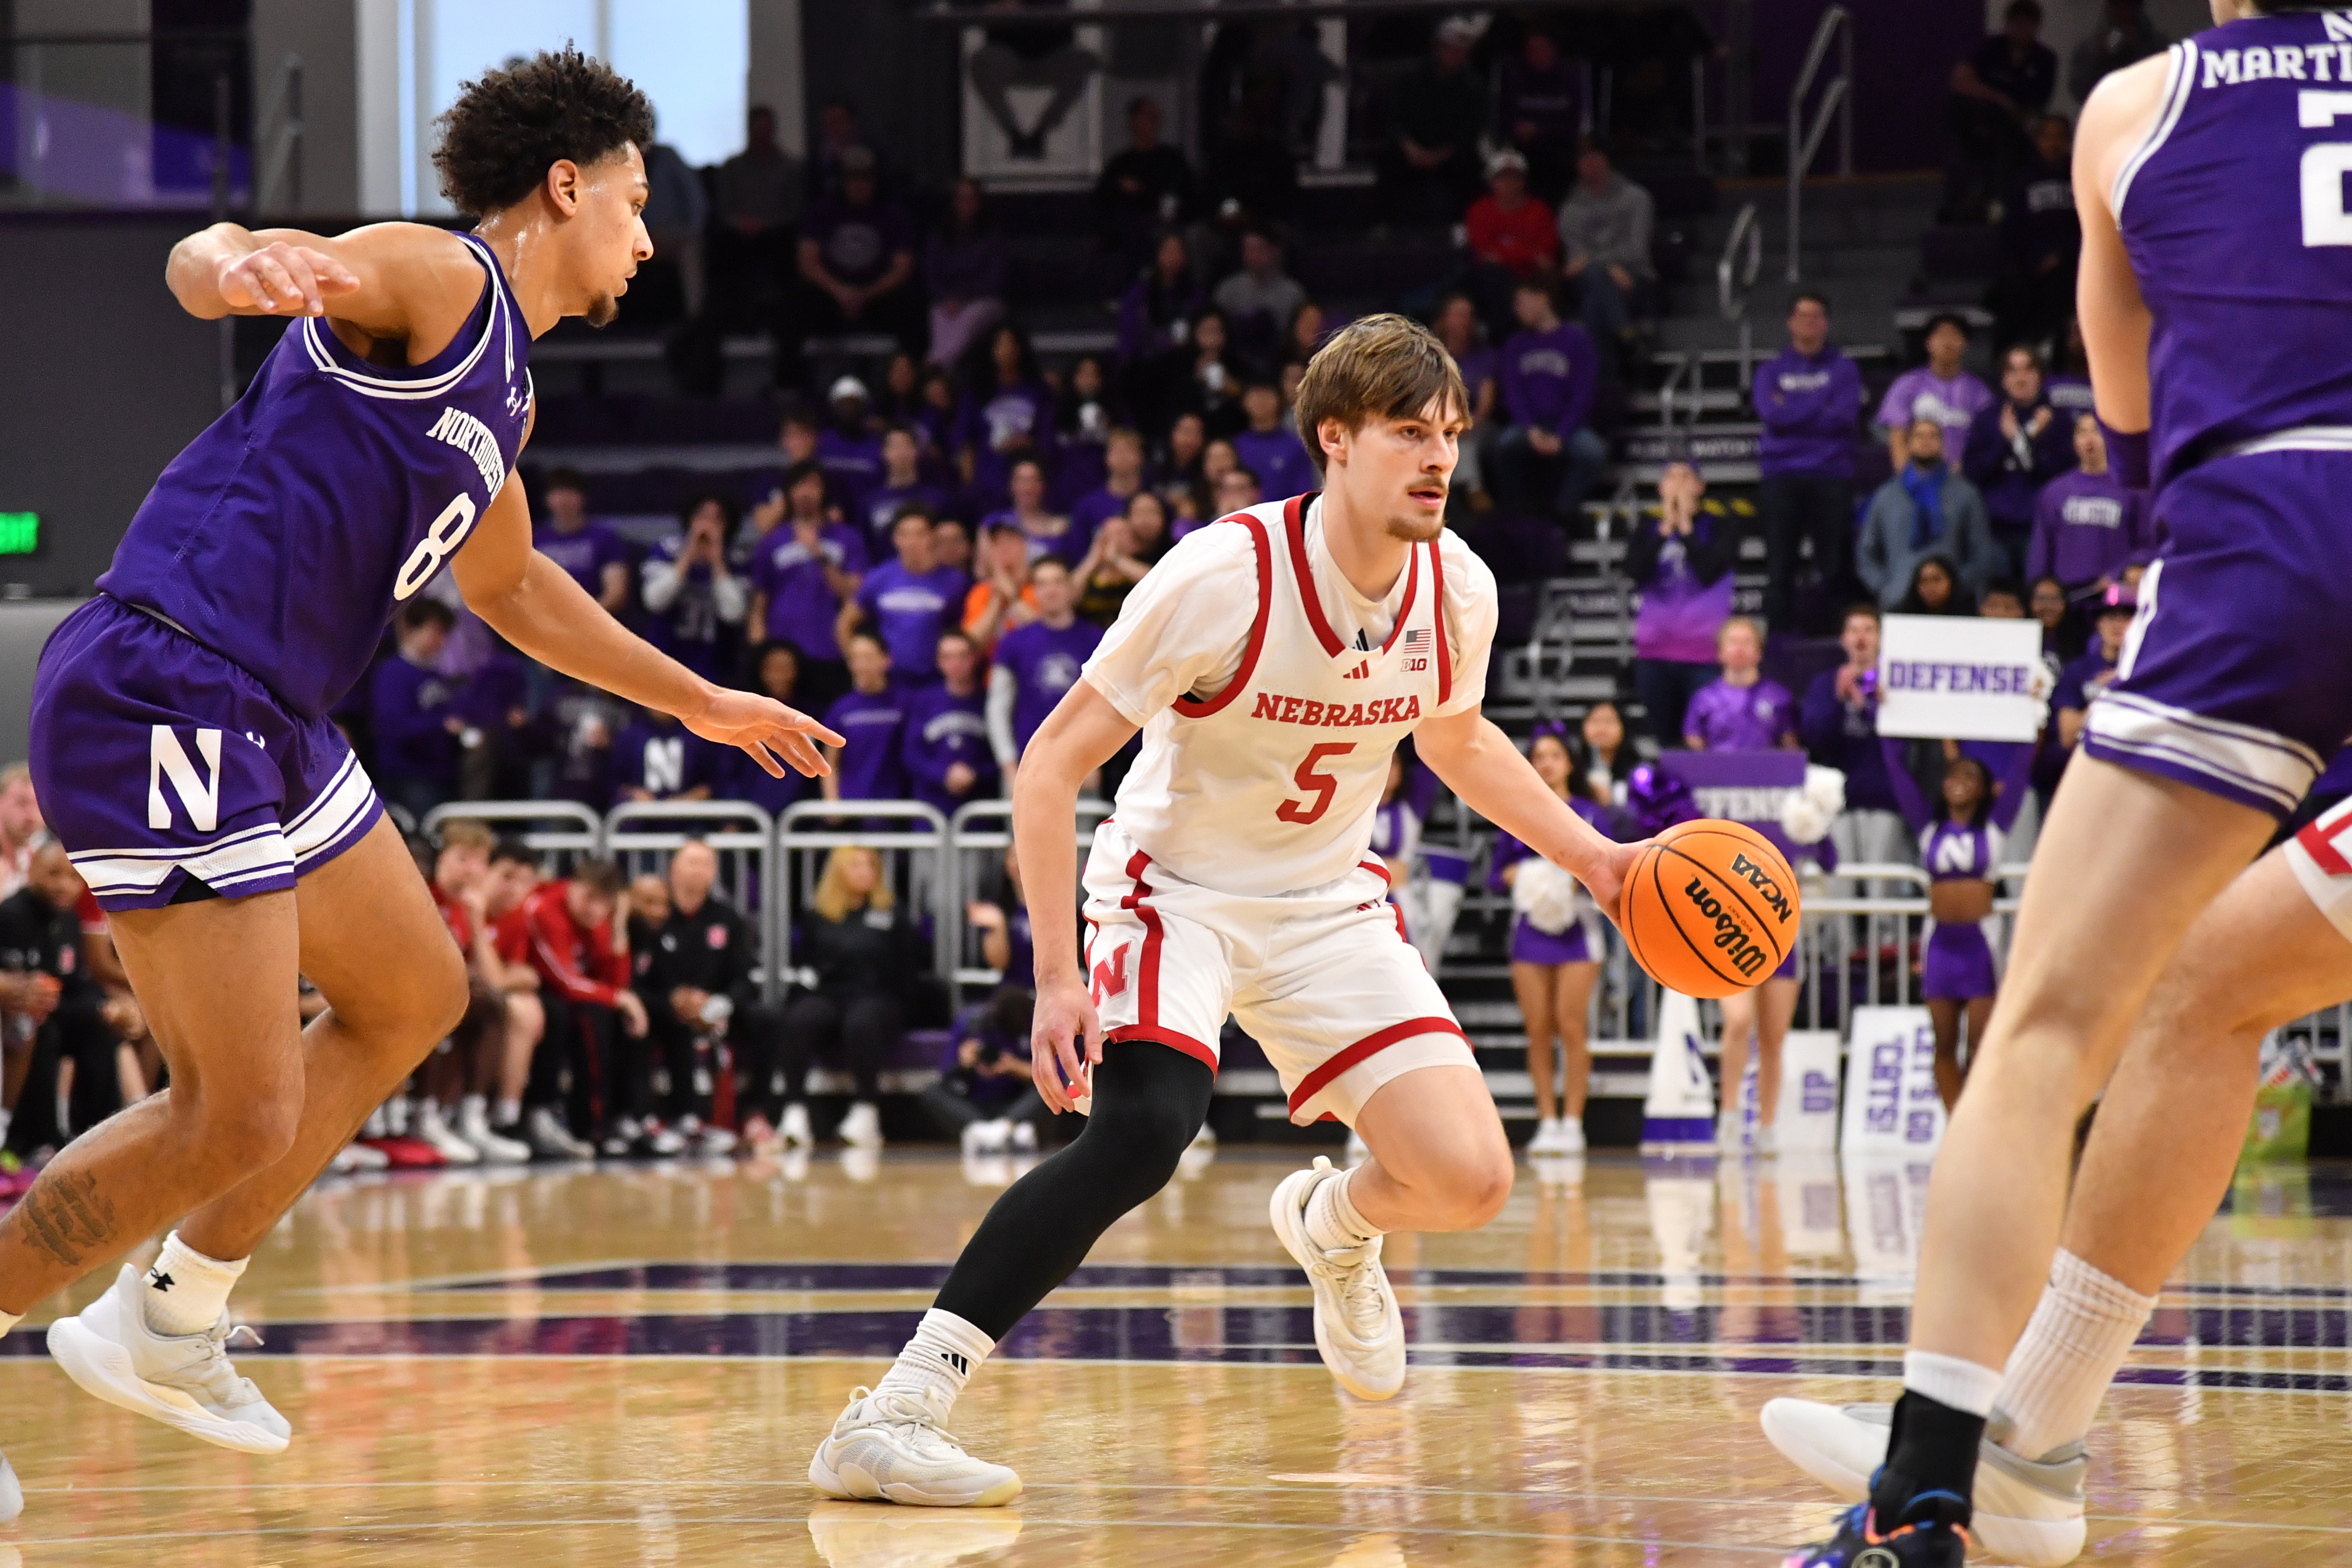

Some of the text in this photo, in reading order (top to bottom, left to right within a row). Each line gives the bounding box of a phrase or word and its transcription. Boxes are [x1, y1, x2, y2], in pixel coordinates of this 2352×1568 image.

[394, 492, 476, 601] 8
[1889, 660, 2030, 695] DEFENSE
[1251, 692, 1421, 727] NEBRASKA
[148, 724, 222, 831] N
[644, 736, 684, 792] N
[1275, 742, 1358, 825] 5
[1693, 786, 1791, 822] EFENS
[1936, 833, 1976, 873] N
[1730, 852, 1793, 925] NCAA
[1684, 876, 1767, 978] Wilson
[1092, 940, 1132, 1009] N
[1804, 1072, 1834, 1112] UP
